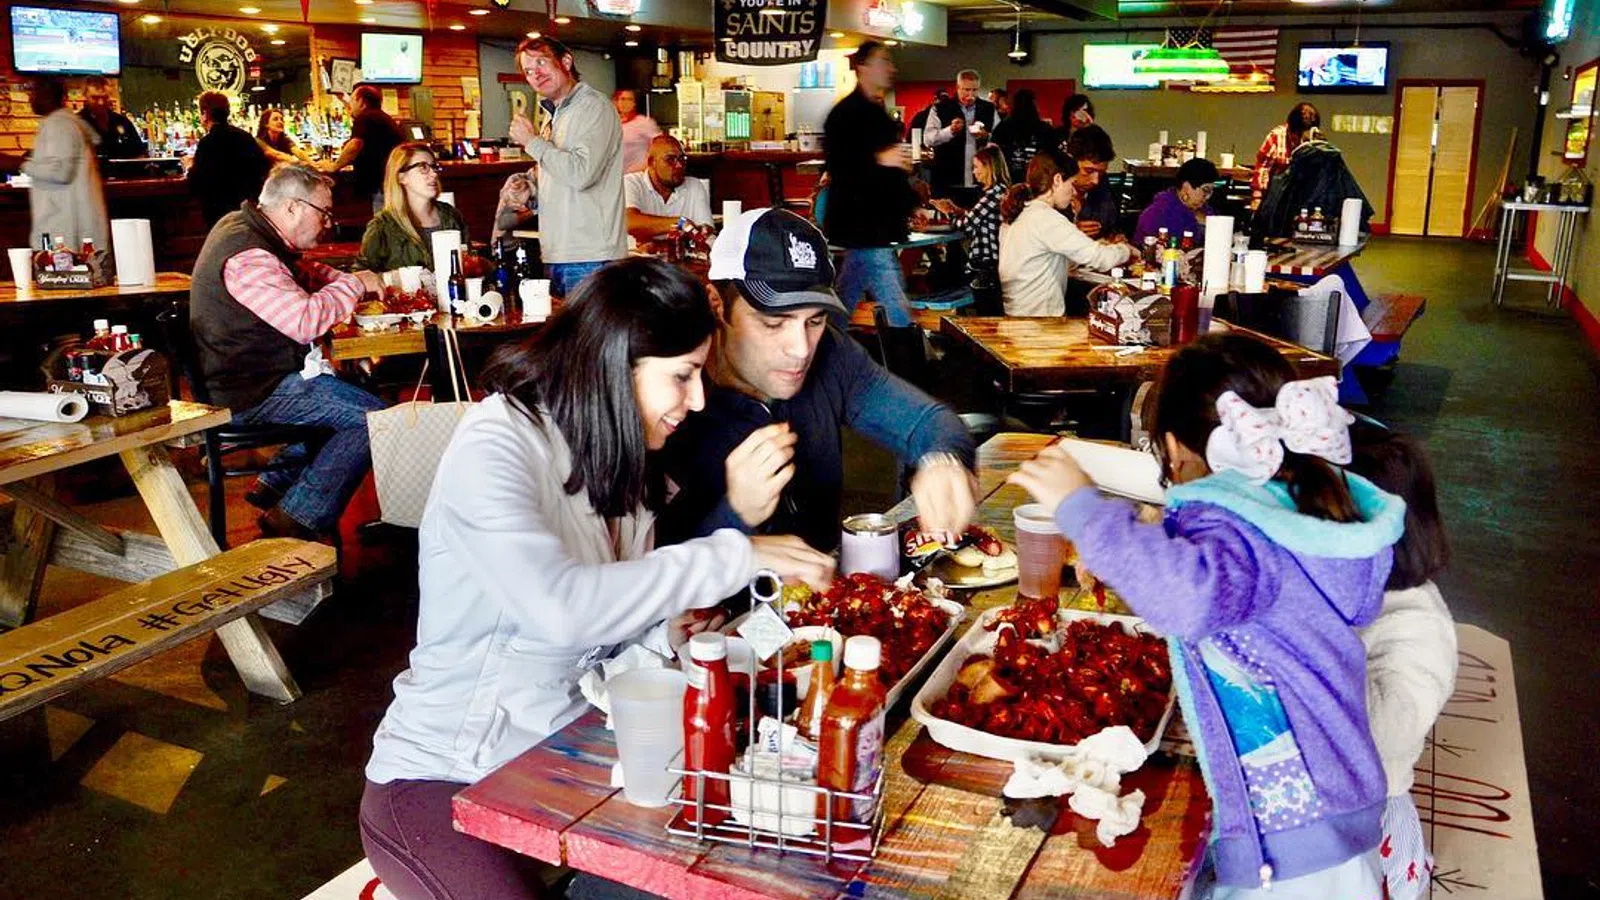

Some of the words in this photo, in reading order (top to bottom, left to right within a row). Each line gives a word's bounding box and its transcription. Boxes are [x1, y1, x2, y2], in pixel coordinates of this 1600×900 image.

[726, 9, 817, 36] SAINTS
[224, 28, 257, 63] DOG
[725, 40, 815, 59] COUNTRY
